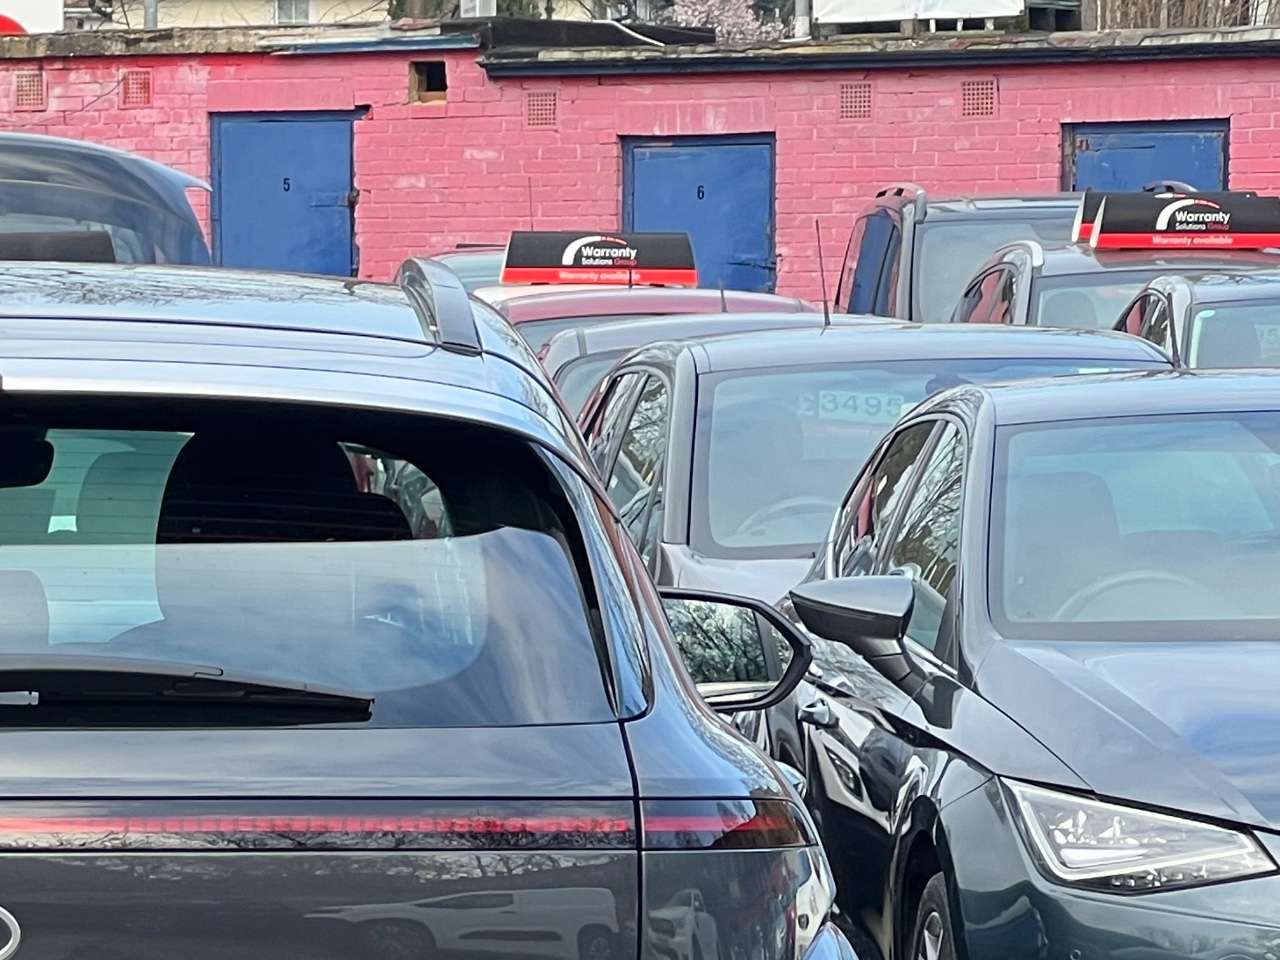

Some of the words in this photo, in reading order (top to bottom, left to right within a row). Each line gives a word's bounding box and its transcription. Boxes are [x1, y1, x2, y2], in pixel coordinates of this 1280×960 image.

[283, 177, 291, 193] 5
[697, 184, 705, 200] 6
[1175, 211, 1231, 224] Warranty
[1175, 222, 1207, 231] Solutions
[1152, 235, 1192, 246] Warranty
[581, 246, 638, 260] Warranty
[581, 257, 613, 266] Solutions
